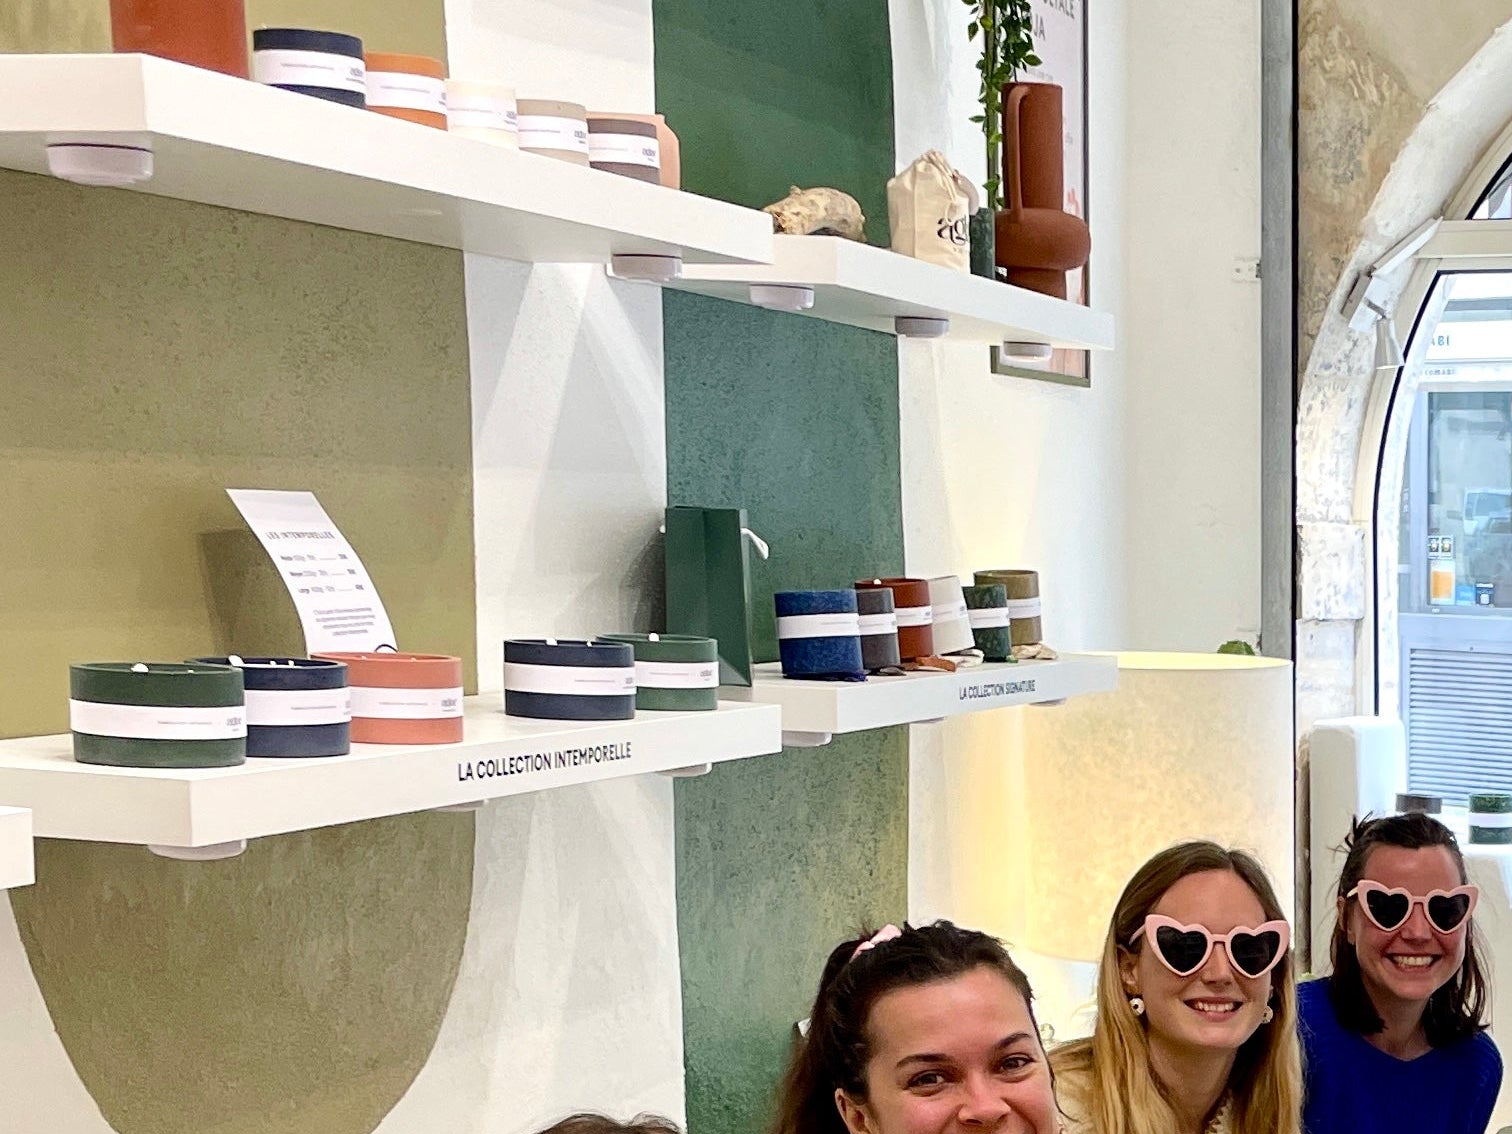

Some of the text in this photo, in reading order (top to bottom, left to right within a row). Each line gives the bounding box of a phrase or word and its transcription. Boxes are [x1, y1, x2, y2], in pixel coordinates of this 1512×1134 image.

[959, 679, 1036, 700] LA COLLECTION SIGNATURE
[458, 742, 632, 781] LA COLLECTION INTEMPORELLE
